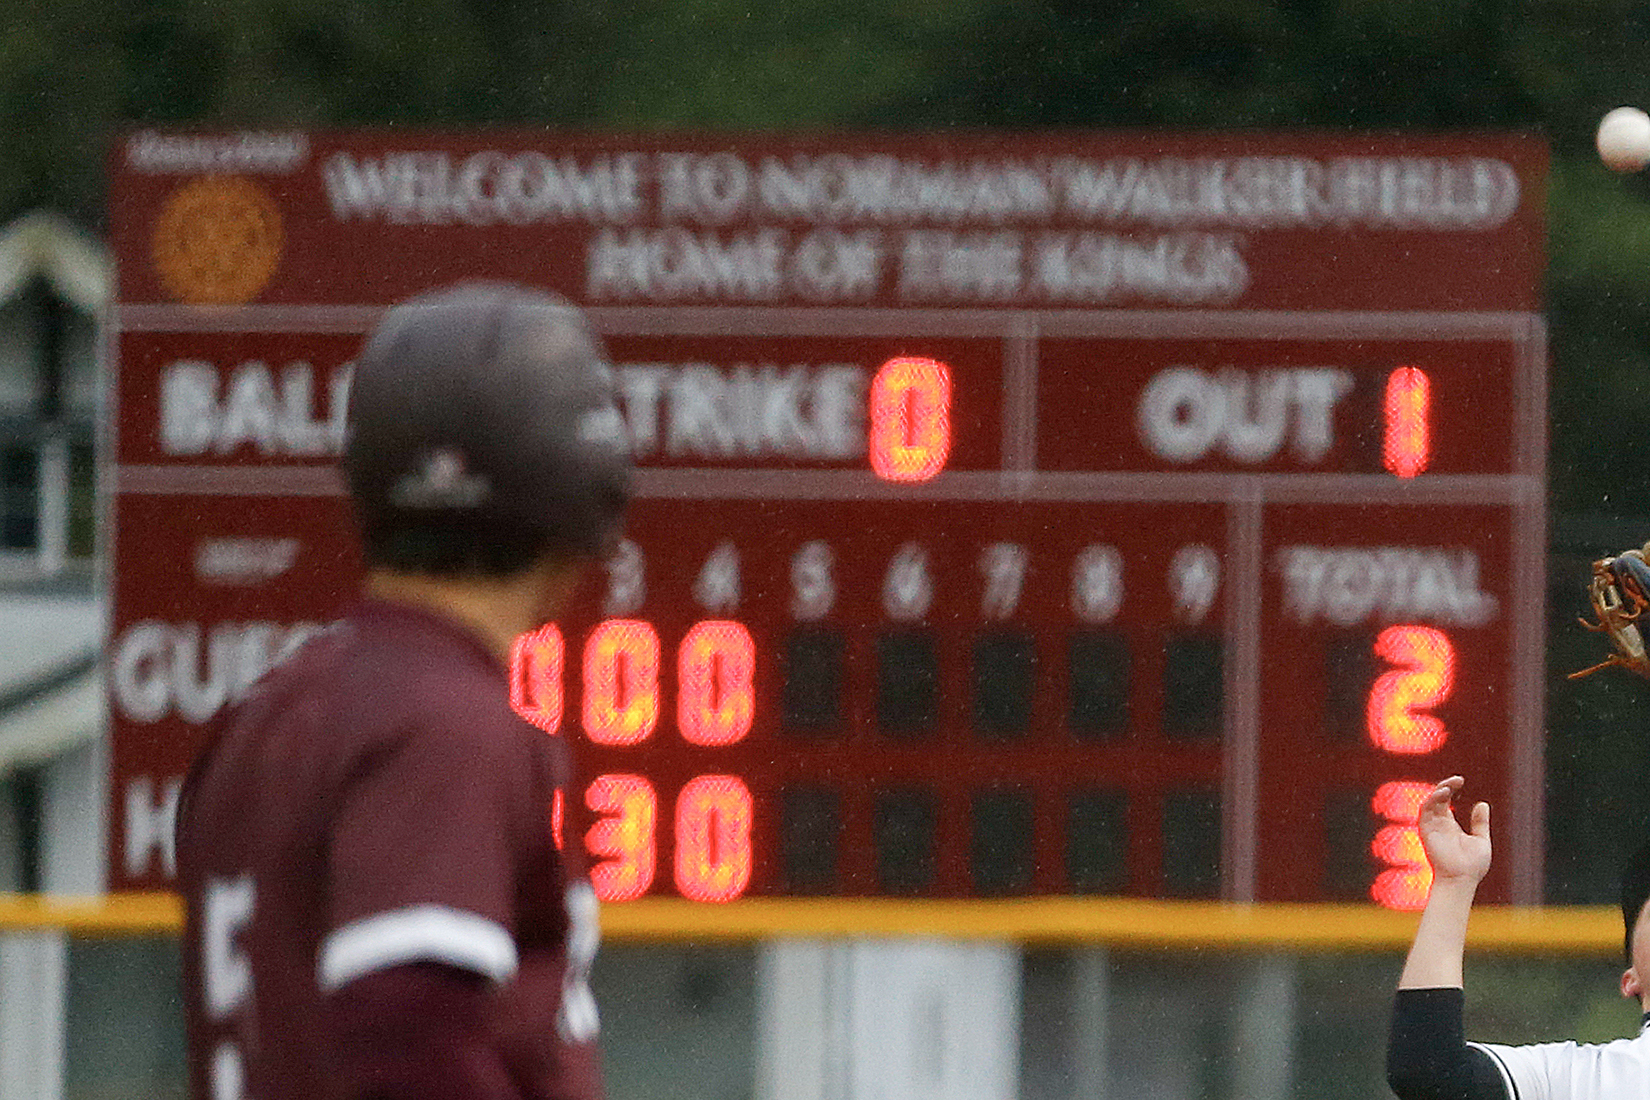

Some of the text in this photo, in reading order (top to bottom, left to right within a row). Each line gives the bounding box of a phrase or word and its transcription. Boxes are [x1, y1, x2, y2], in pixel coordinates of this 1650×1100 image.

[322, 150, 642, 226] WELCOME
[657, 152, 751, 225] TO
[759, 153, 1048, 228] NORMAN
[1054, 155, 1322, 230] WALKER
[1330, 156, 1522, 231] FIELD
[586, 227, 1250, 301] HOME OF THE KINGS
[600, 360, 864, 460] TRIKE
[870, 356, 953, 482] 0
[1136, 365, 1354, 463] OUT
[1382, 366, 1430, 479] 1
[1280, 545, 1497, 625] TOTAL
[582, 618, 661, 746] 0
[676, 619, 756, 746] 0
[1366, 625, 1455, 755] 2
[584, 774, 657, 902] 3
[674, 774, 753, 902] 0
